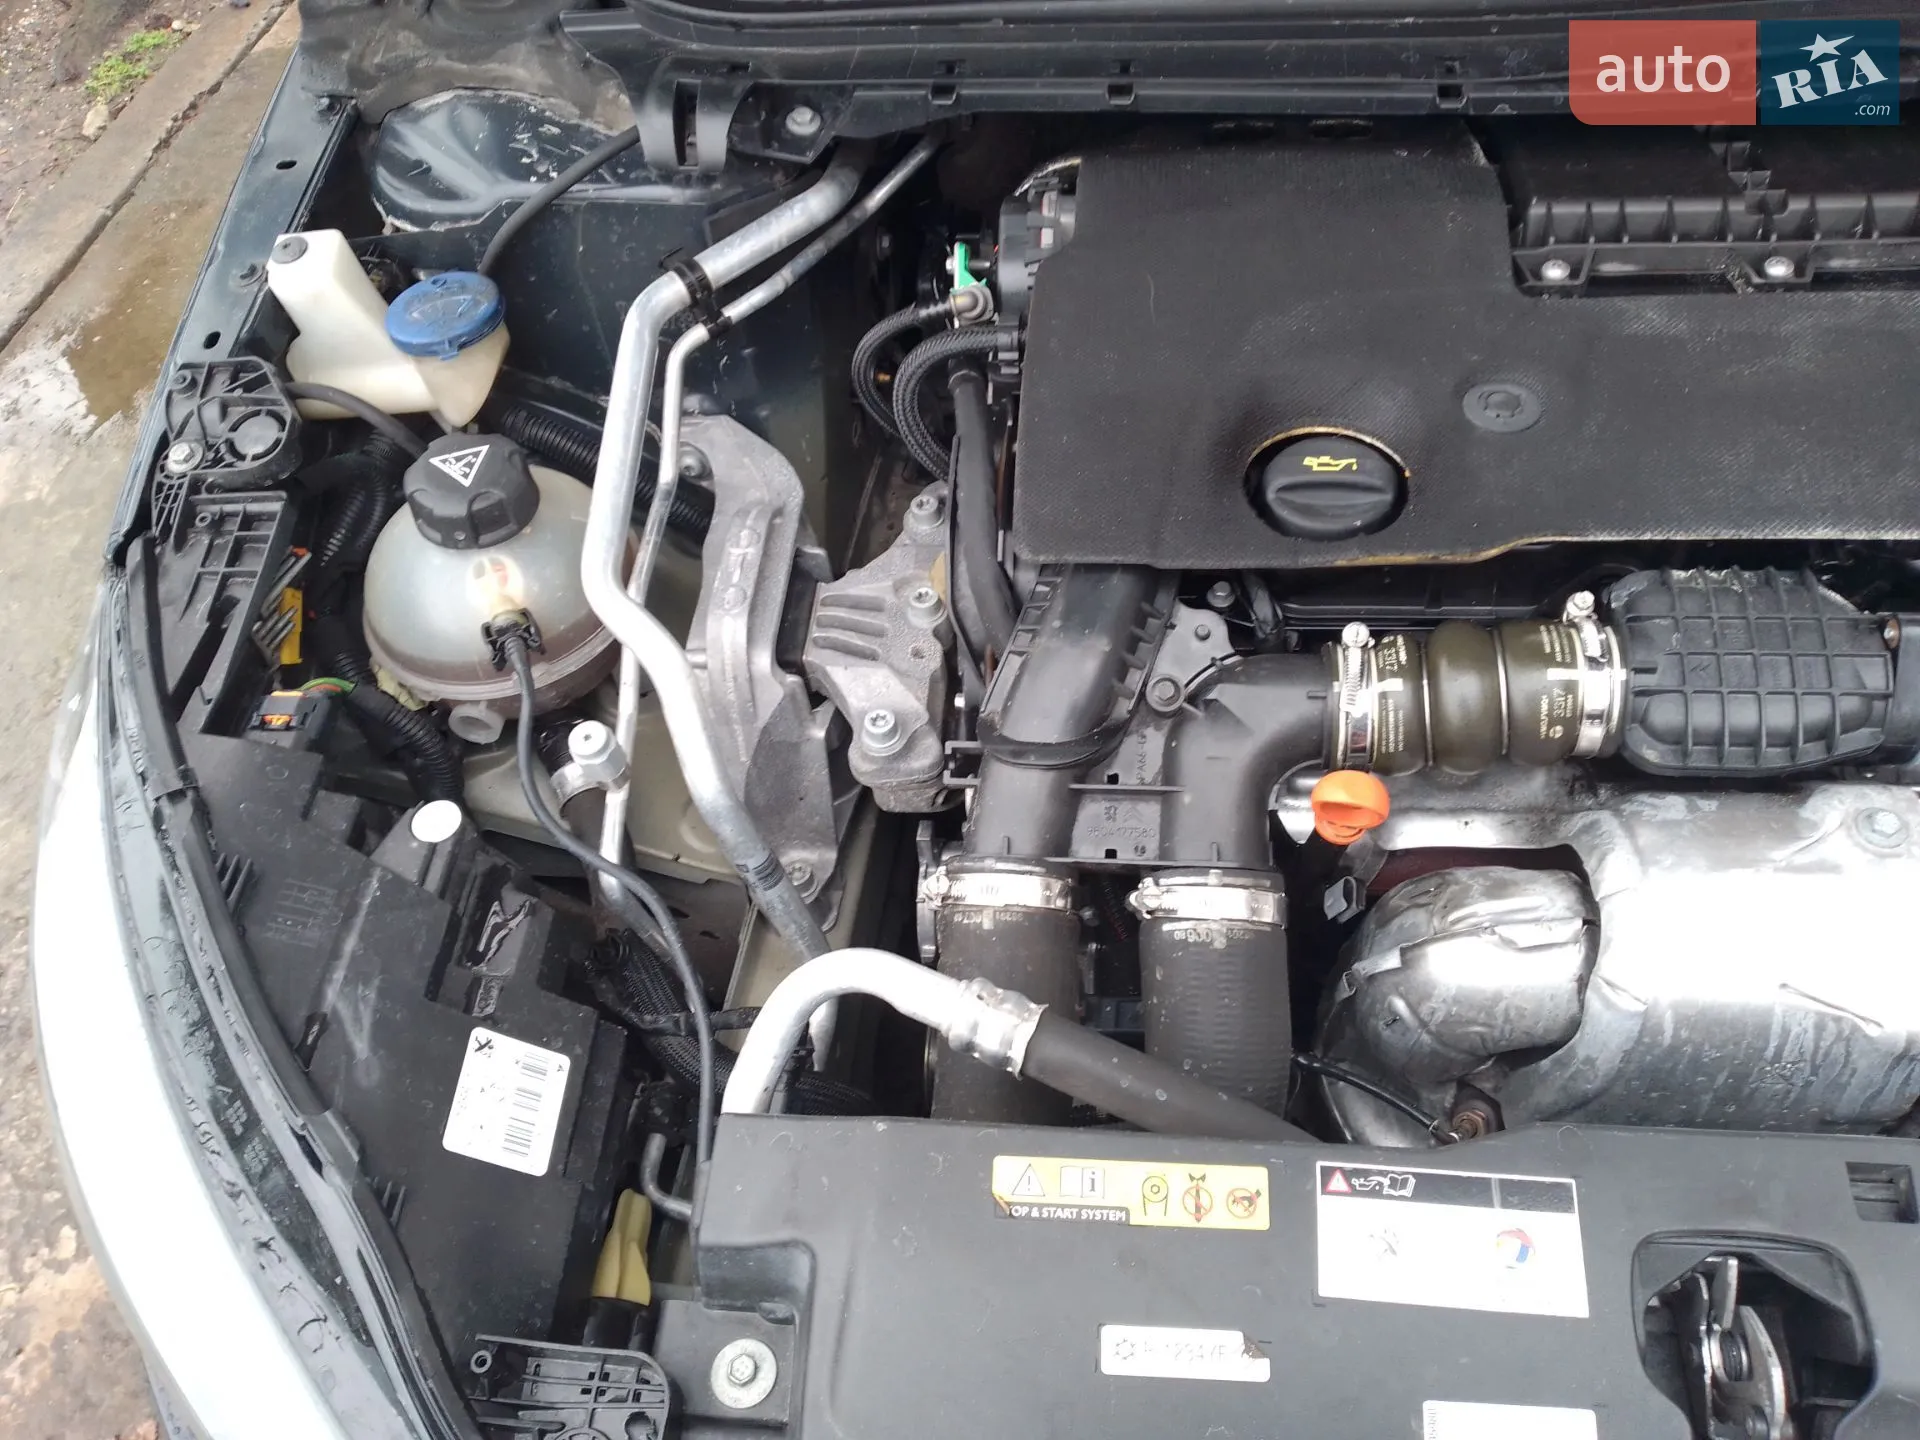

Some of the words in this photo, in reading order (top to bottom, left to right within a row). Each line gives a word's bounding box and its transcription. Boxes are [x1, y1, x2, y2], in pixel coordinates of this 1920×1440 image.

[1031, 1207, 1039, 1217] &
[1041, 1207, 1078, 1220] START
[1080, 1209, 1126, 1222] SYSTEM
